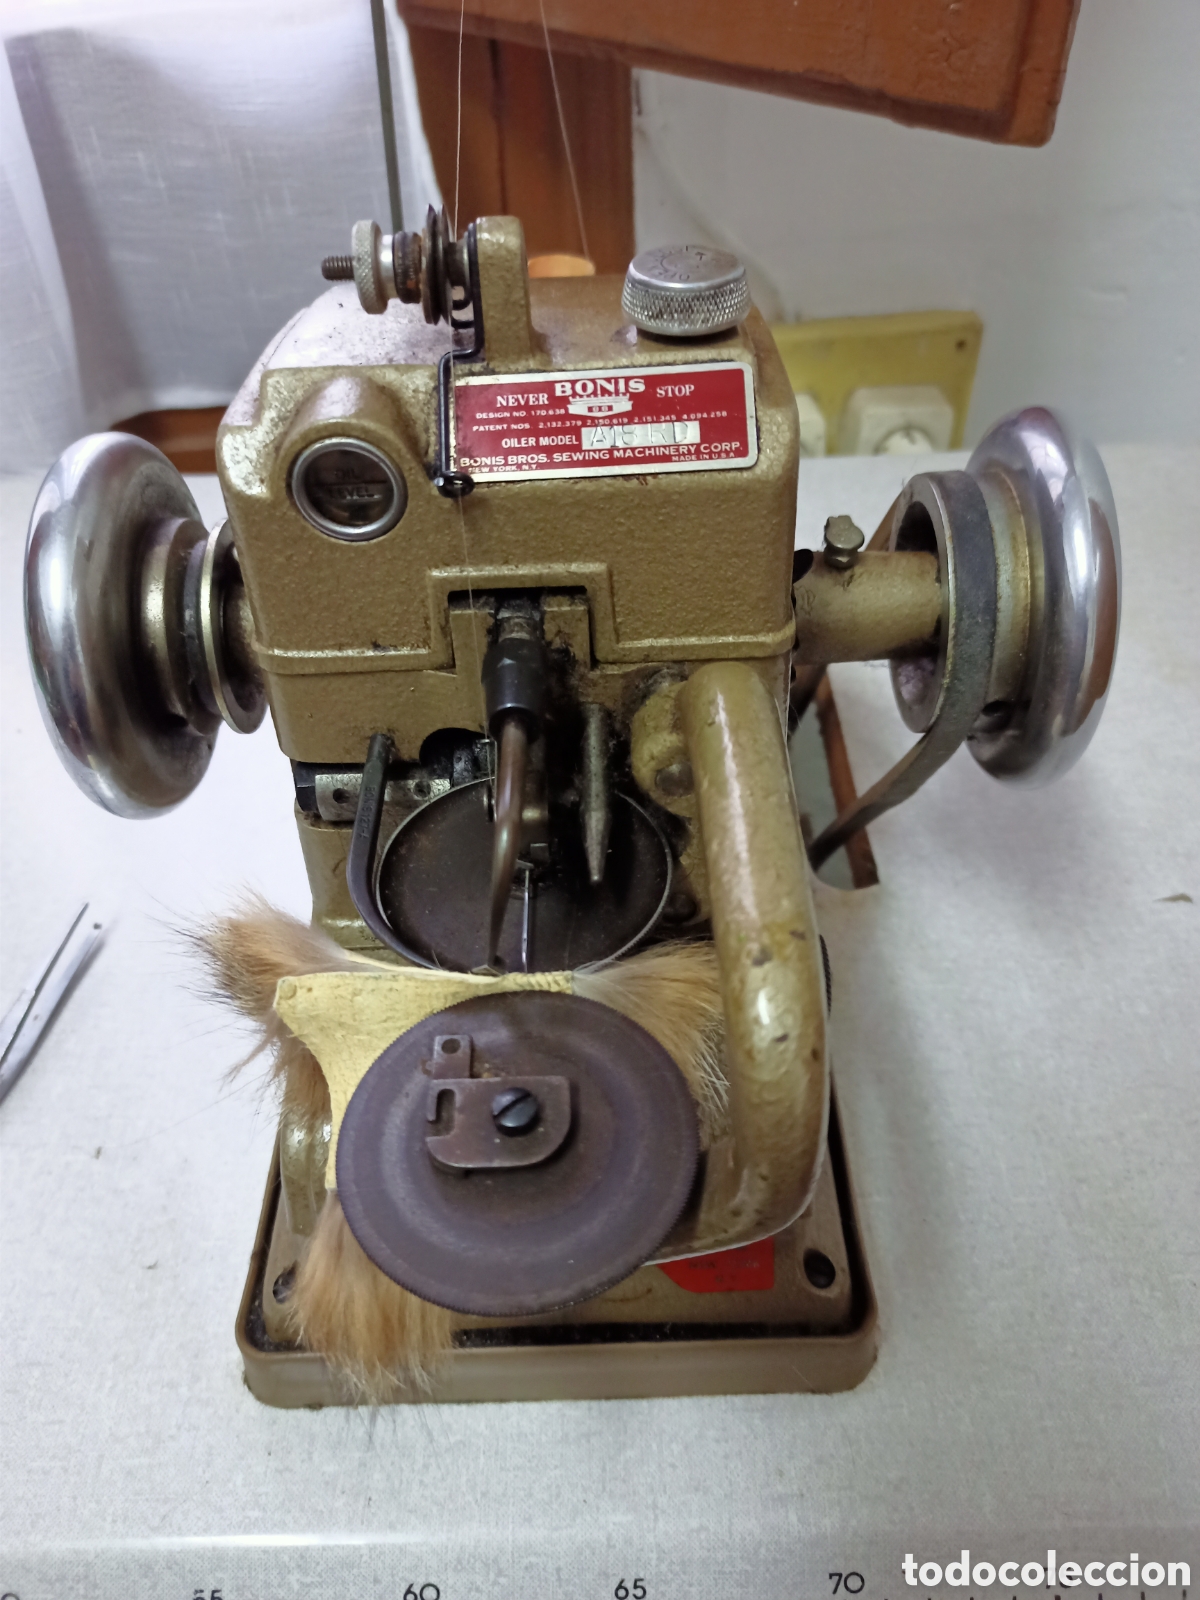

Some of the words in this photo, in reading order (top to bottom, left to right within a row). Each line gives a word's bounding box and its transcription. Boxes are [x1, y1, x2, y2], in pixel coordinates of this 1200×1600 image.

[496, 393, 549, 407] NEVER
[656, 384, 695, 398] STOP
[554, 378, 646, 397] BONIS
[475, 411, 511, 420] DESIGN
[512, 410, 529, 418] NO.
[472, 424, 508, 432] PATENT
[501, 436, 536, 449] OILER
[539, 434, 579, 447] MODEL
[460, 455, 505, 467] BONIS
[507, 453, 551, 465] BROS.
[552, 450, 610, 463] SEWING
[613, 445, 697, 460] MACHINERY
[699, 441, 743, 454] CORP.
[671, 454, 698, 462] MADE
[699, 452, 710, 460] IN
[403, 1582, 441, 1600] 60
[614, 1577, 647, 1600] 65
[828, 1571, 866, 1595] 70
